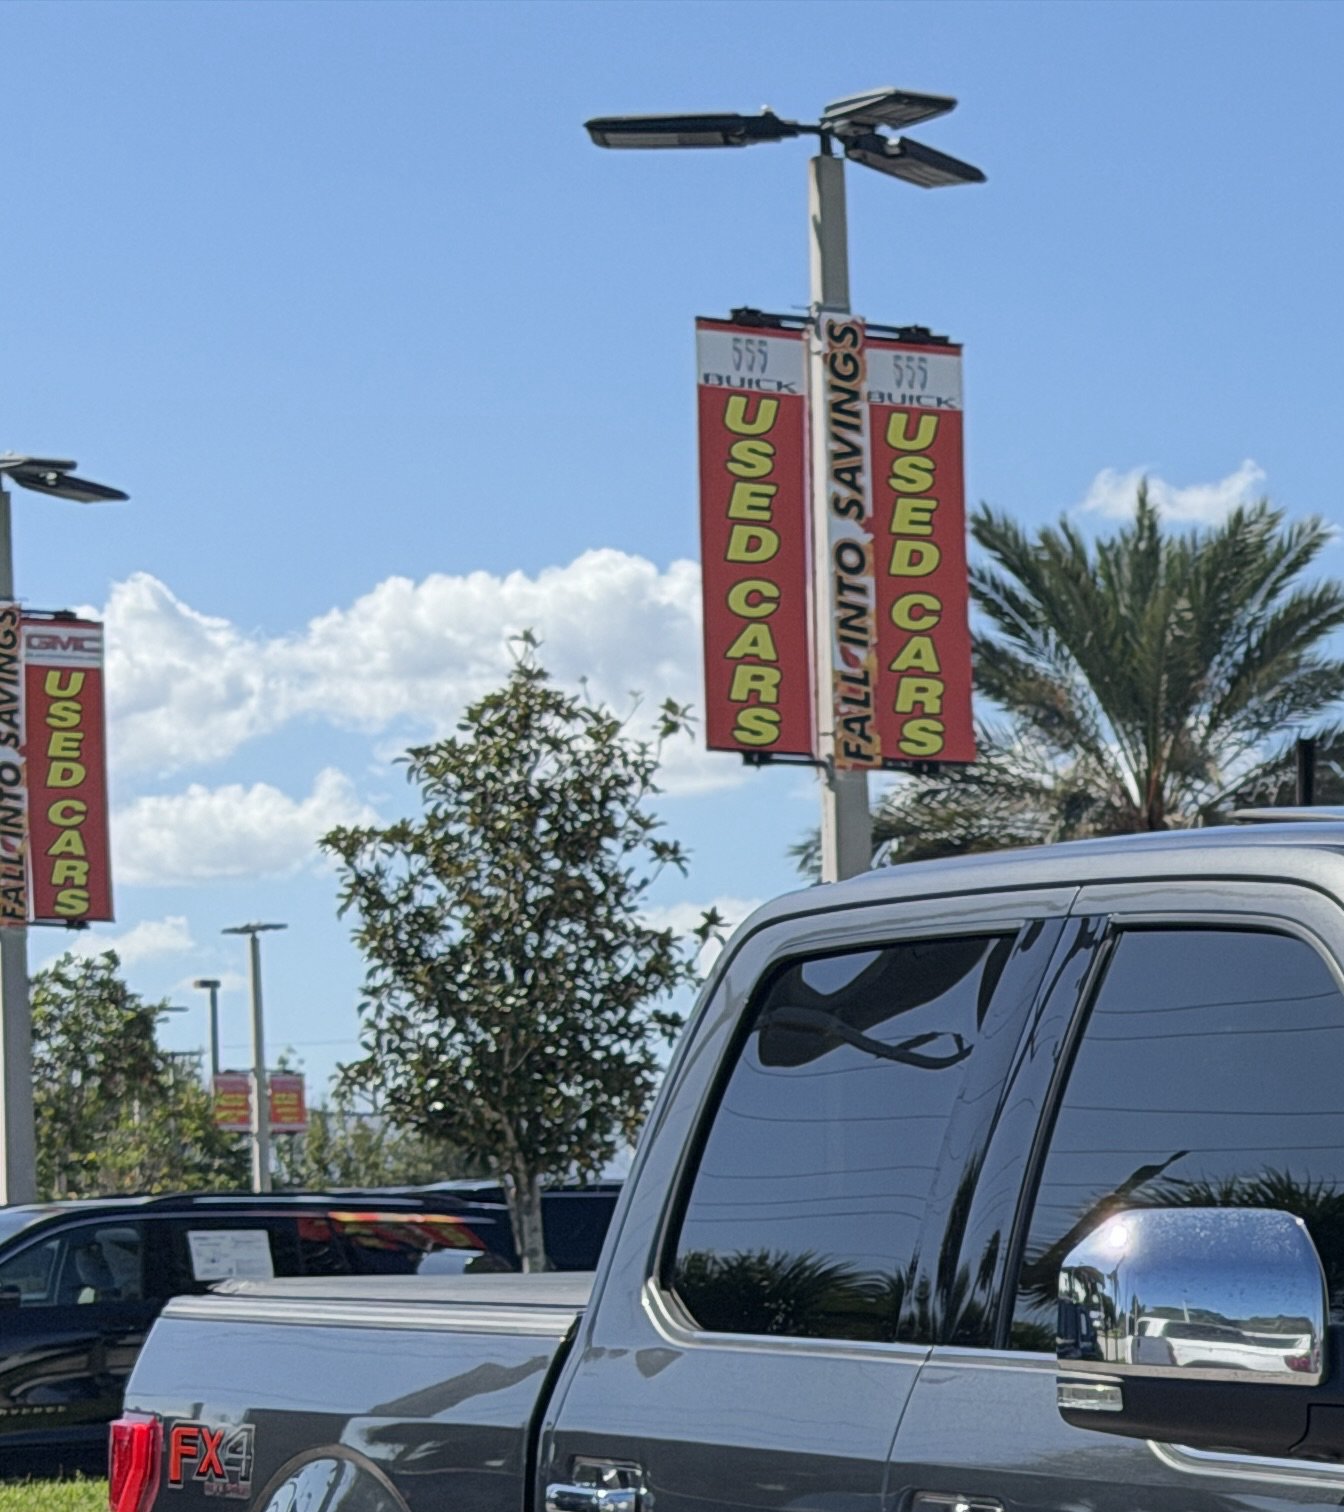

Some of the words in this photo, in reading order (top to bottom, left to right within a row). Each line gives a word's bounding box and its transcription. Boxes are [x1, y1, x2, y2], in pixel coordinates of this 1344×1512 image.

[703, 373, 797, 394] BUICK
[827, 319, 865, 523] SAVINGS
[867, 391, 957, 409] BUICK
[723, 395, 781, 564] USED
[886, 412, 941, 577] USED
[26, 634, 104, 653] GMC
[835, 539, 870, 648] INTO
[724, 580, 782, 747] CARS
[843, 667, 876, 762] FALL
[888, 592, 946, 757] CARS
[44, 669, 86, 788] USED
[0, 761, 23, 839] INTO
[1, 853, 25, 919] FALL
[47, 799, 90, 917] CARS
[168, 1420, 255, 1489] FX4
